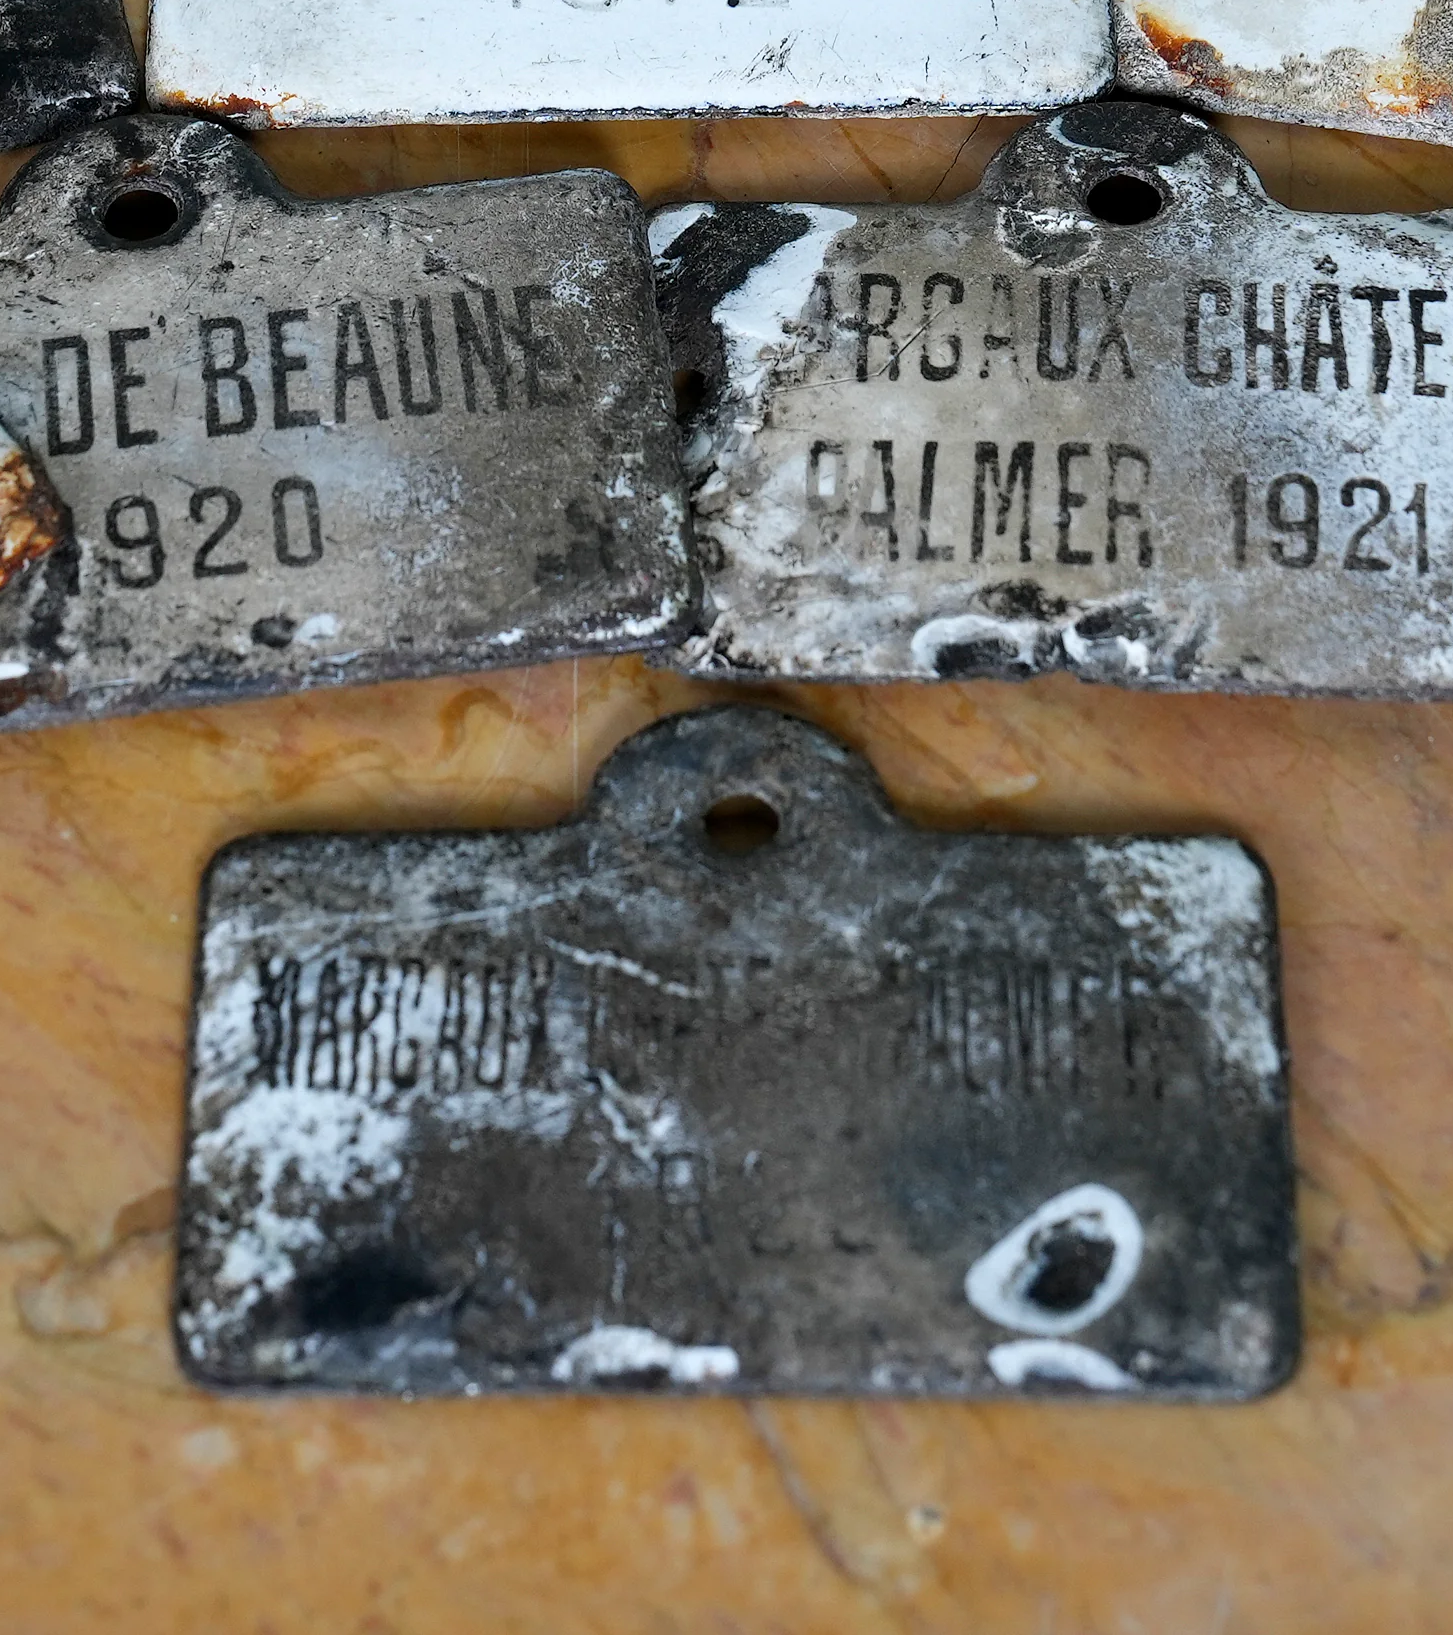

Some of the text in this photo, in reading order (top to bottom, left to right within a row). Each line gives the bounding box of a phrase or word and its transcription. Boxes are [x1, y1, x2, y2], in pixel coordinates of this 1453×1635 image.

[40, 284, 580, 457] DE BEAUNE
[800, 271, 1138, 383] ARGAUX
[1229, 471, 1431, 575] 1921
